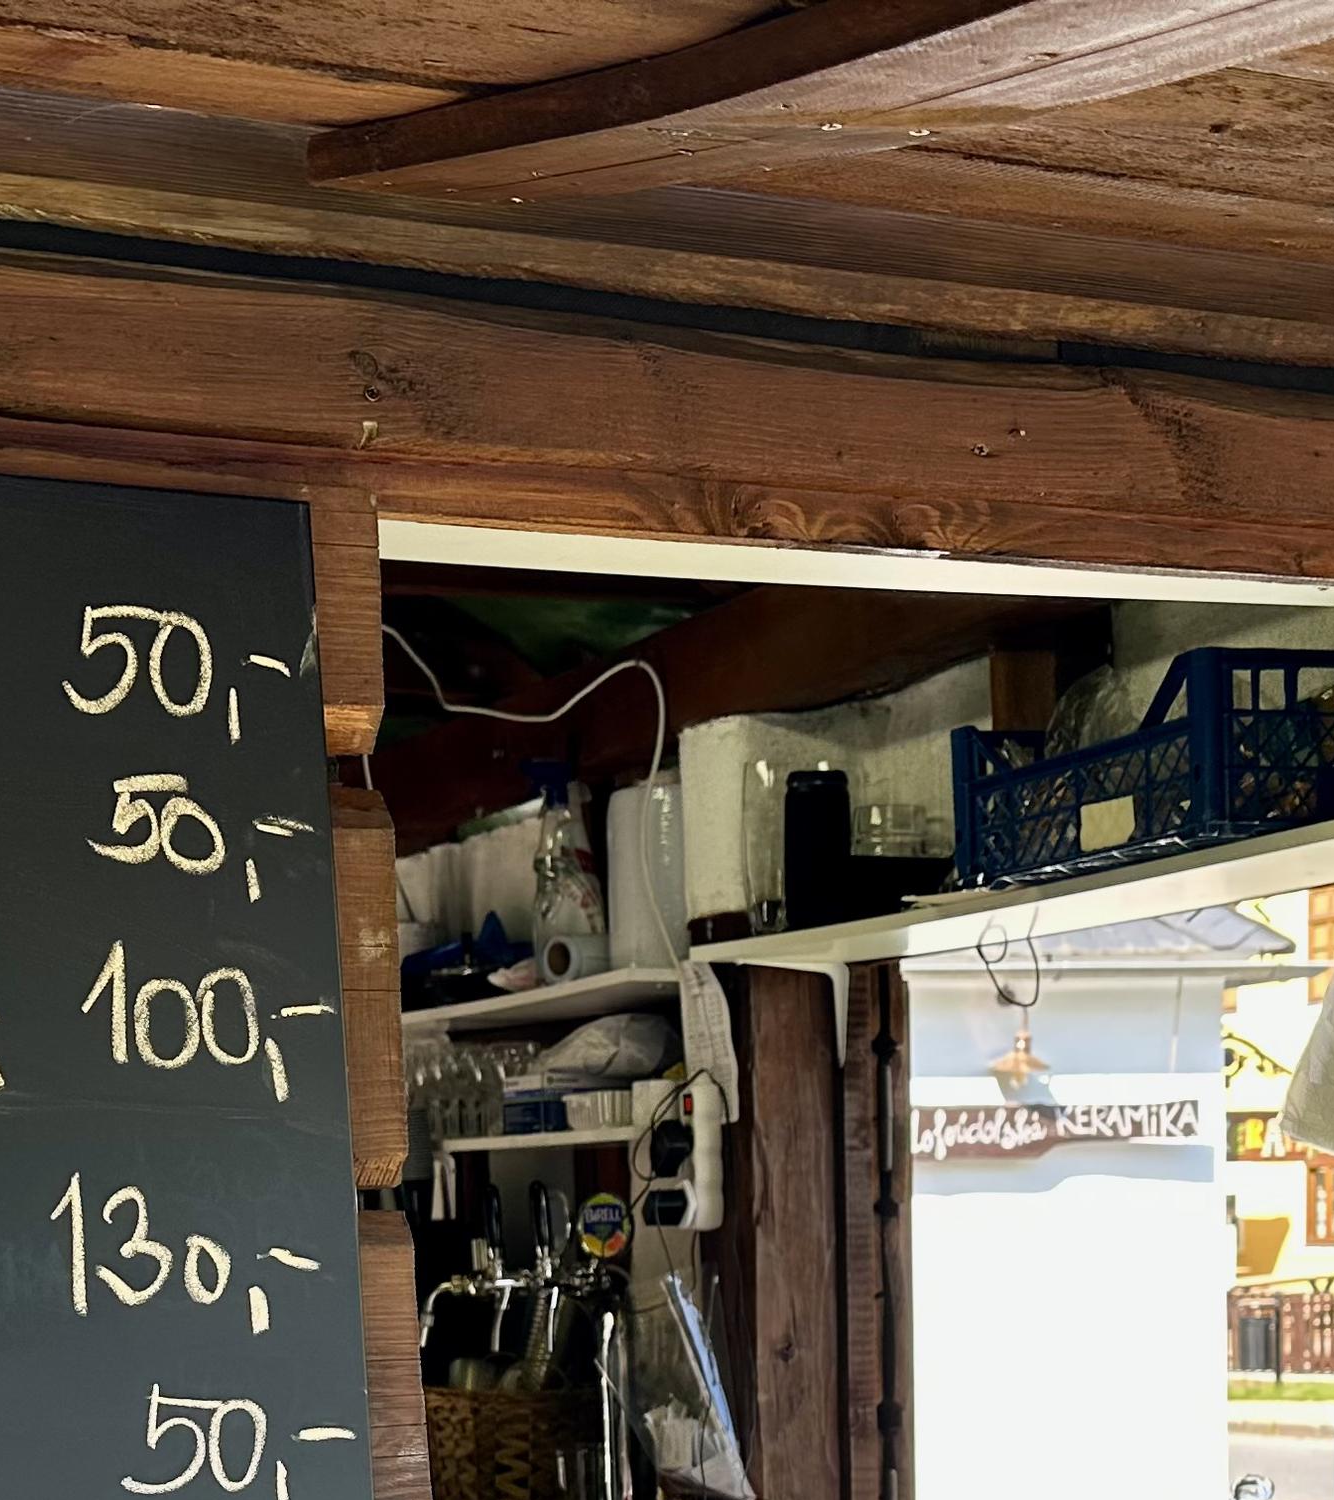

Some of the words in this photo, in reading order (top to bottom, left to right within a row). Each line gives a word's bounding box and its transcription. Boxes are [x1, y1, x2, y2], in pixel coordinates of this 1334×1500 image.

[61, 604, 292, 741] 50,-
[86, 772, 312, 904] 50,-
[80, 938, 336, 1104] 100,-
[49, 1171, 322, 1336] 130,-
